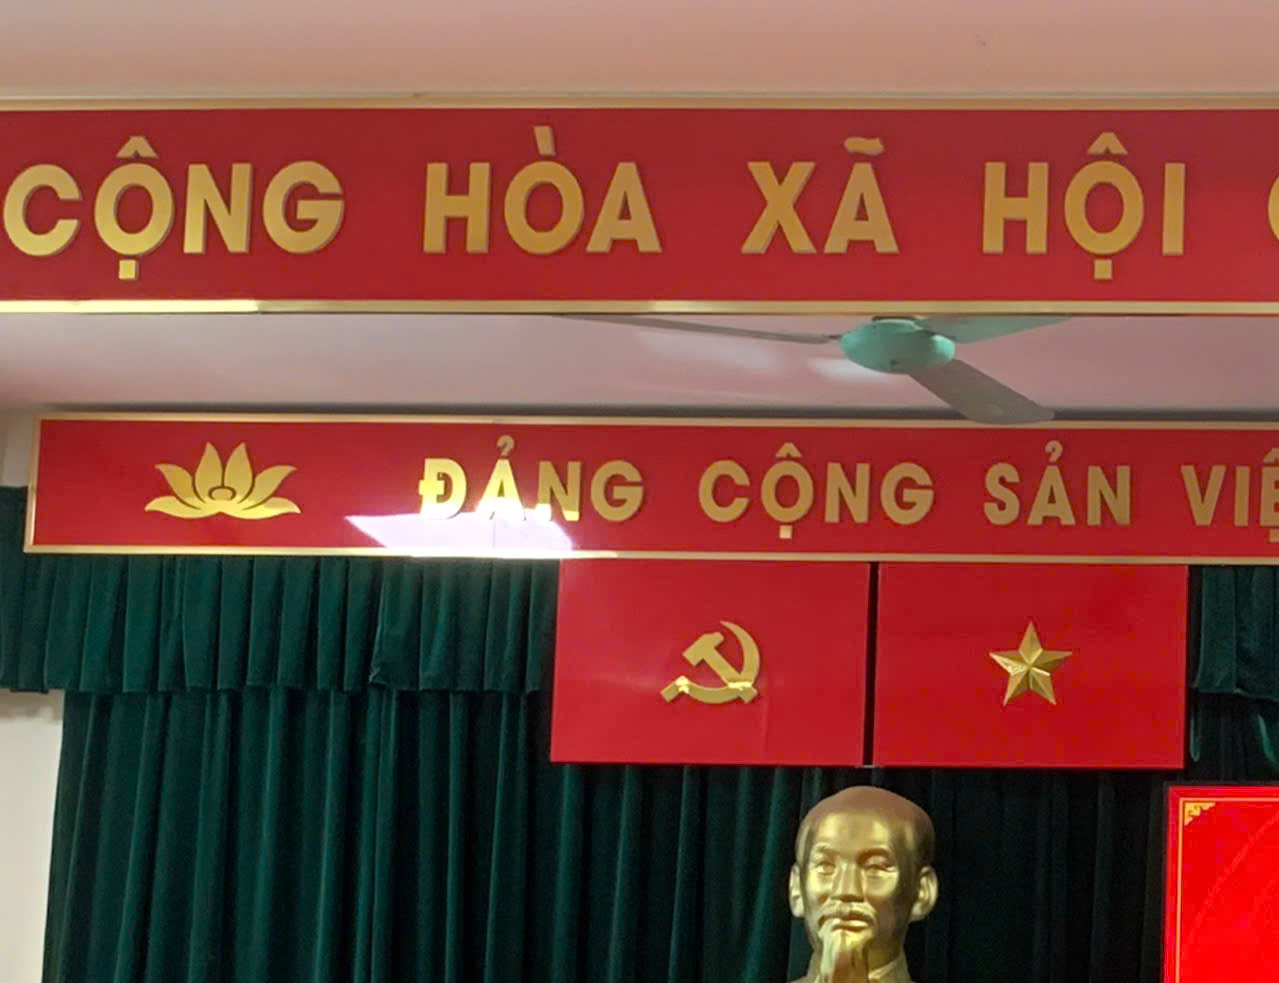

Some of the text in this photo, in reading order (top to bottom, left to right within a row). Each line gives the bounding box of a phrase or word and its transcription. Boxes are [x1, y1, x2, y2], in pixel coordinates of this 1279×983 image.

[3, 136, 345, 281] CỘNG
[423, 126, 662, 255] HÒA
[742, 137, 898, 255] XÃ
[983, 132, 1186, 281] HỘI
[416, 436, 644, 522] ĐẢNG
[699, 443, 934, 540] CỘNG
[983, 441, 1132, 526] SẢN
